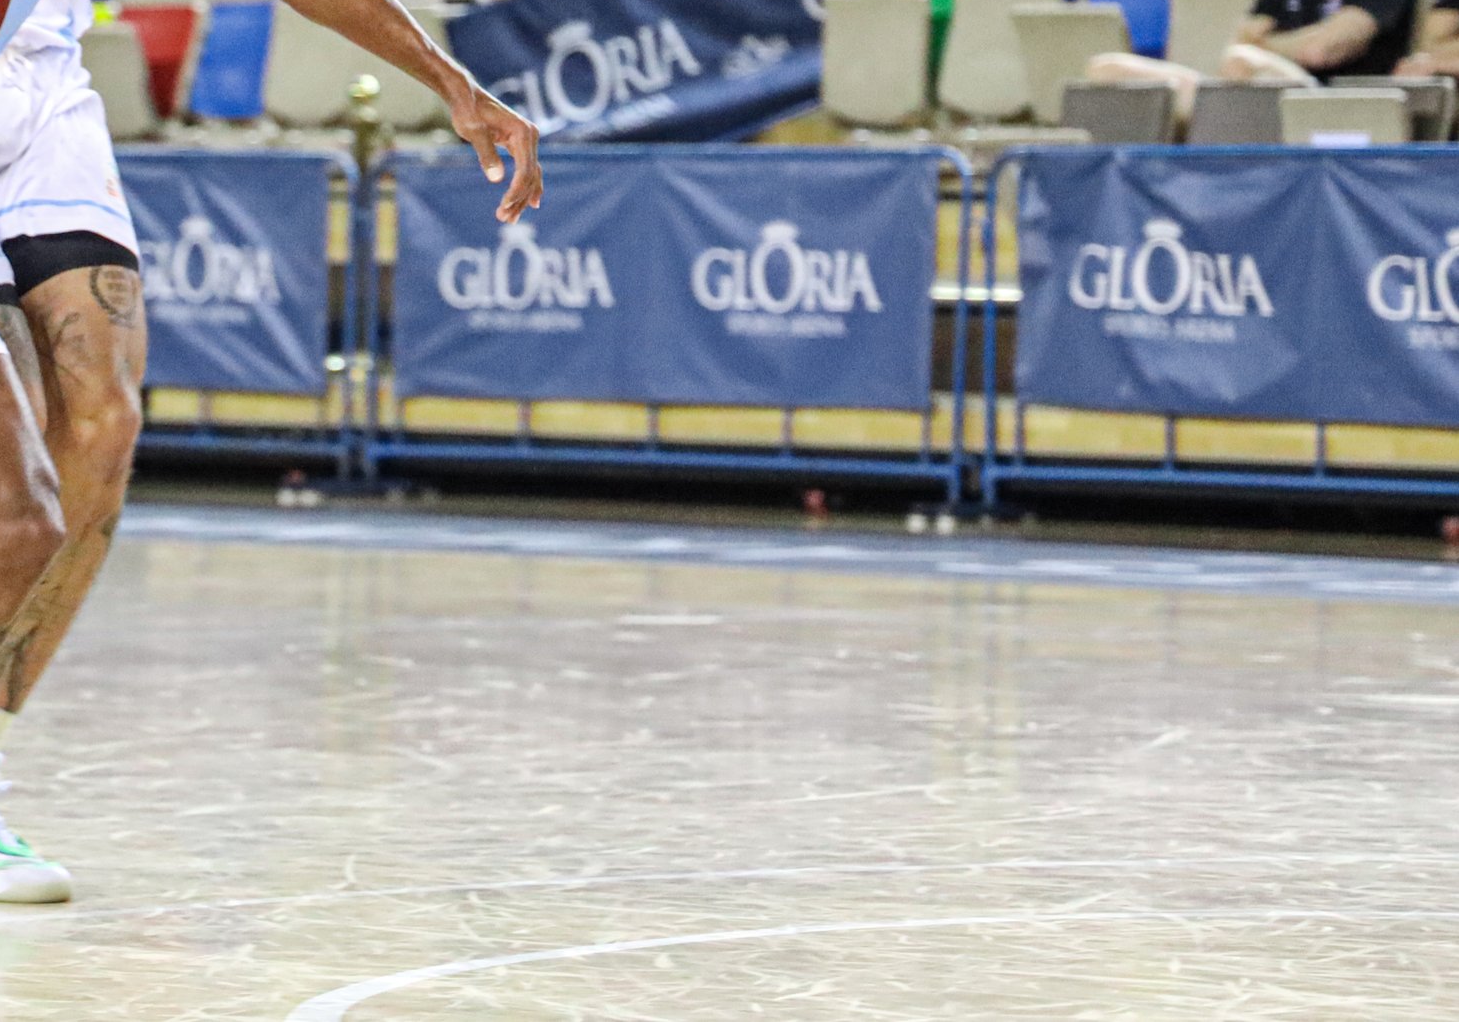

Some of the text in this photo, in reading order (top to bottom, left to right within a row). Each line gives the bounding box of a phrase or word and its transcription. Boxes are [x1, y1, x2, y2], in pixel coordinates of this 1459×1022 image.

[438, 222, 616, 311] GLORIA
[693, 220, 884, 314] GLORIA
[1069, 219, 1275, 317] GLORIA
